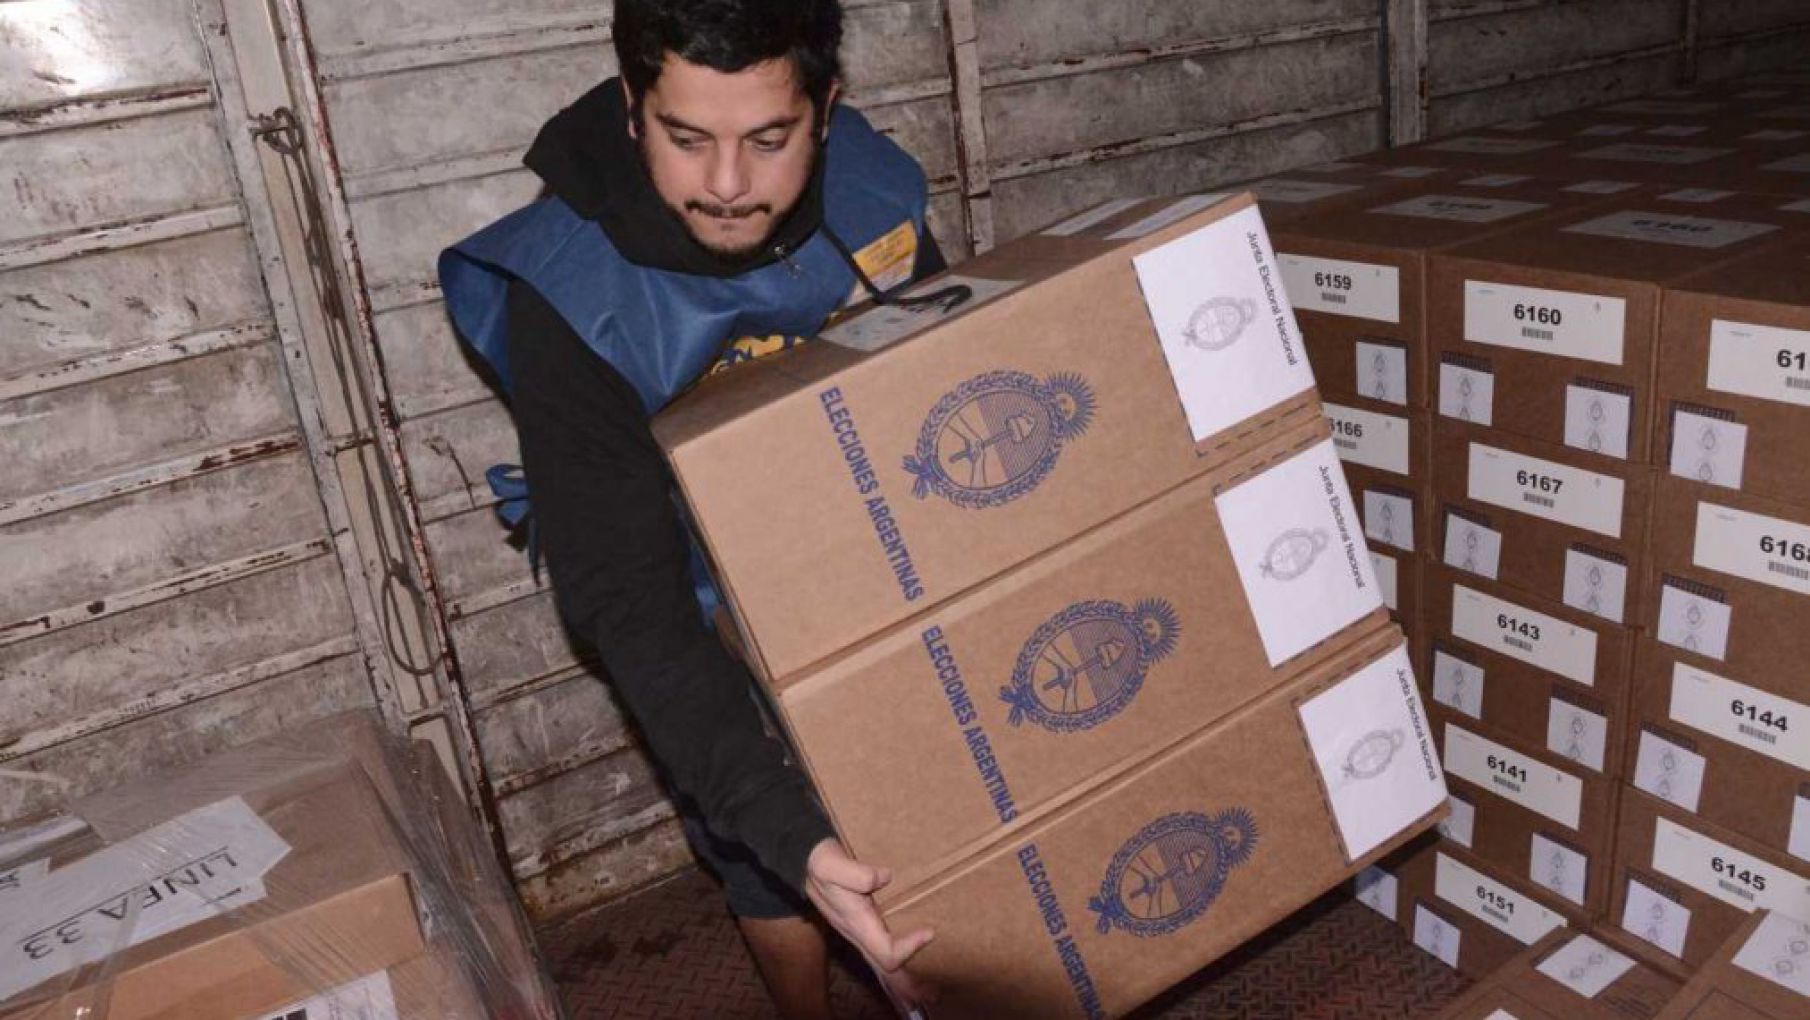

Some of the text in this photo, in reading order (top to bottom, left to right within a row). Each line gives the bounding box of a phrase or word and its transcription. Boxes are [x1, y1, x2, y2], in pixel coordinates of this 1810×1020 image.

[1314, 271, 1352, 291] 6159
[1247, 231, 1297, 365] Junta Electoral Nacional
[1513, 303, 1562, 326] 6160
[820, 387, 925, 601] ELECCIONES ARGENTINAS
[1516, 470, 1564, 495] 6167
[1319, 465, 1365, 588] Junta Electoral Nacional
[1759, 535, 1810, 563] 616
[1497, 614, 1540, 641] 6143
[921, 625, 1019, 824] ELECCIONES ARGENTINAS
[1731, 699, 1788, 733] 6144
[1487, 754, 1527, 783] 6141
[1017, 843, 1067, 936] ELECCIONES
[1711, 856, 1767, 892] 6145
[1476, 885, 1515, 915] 6151
